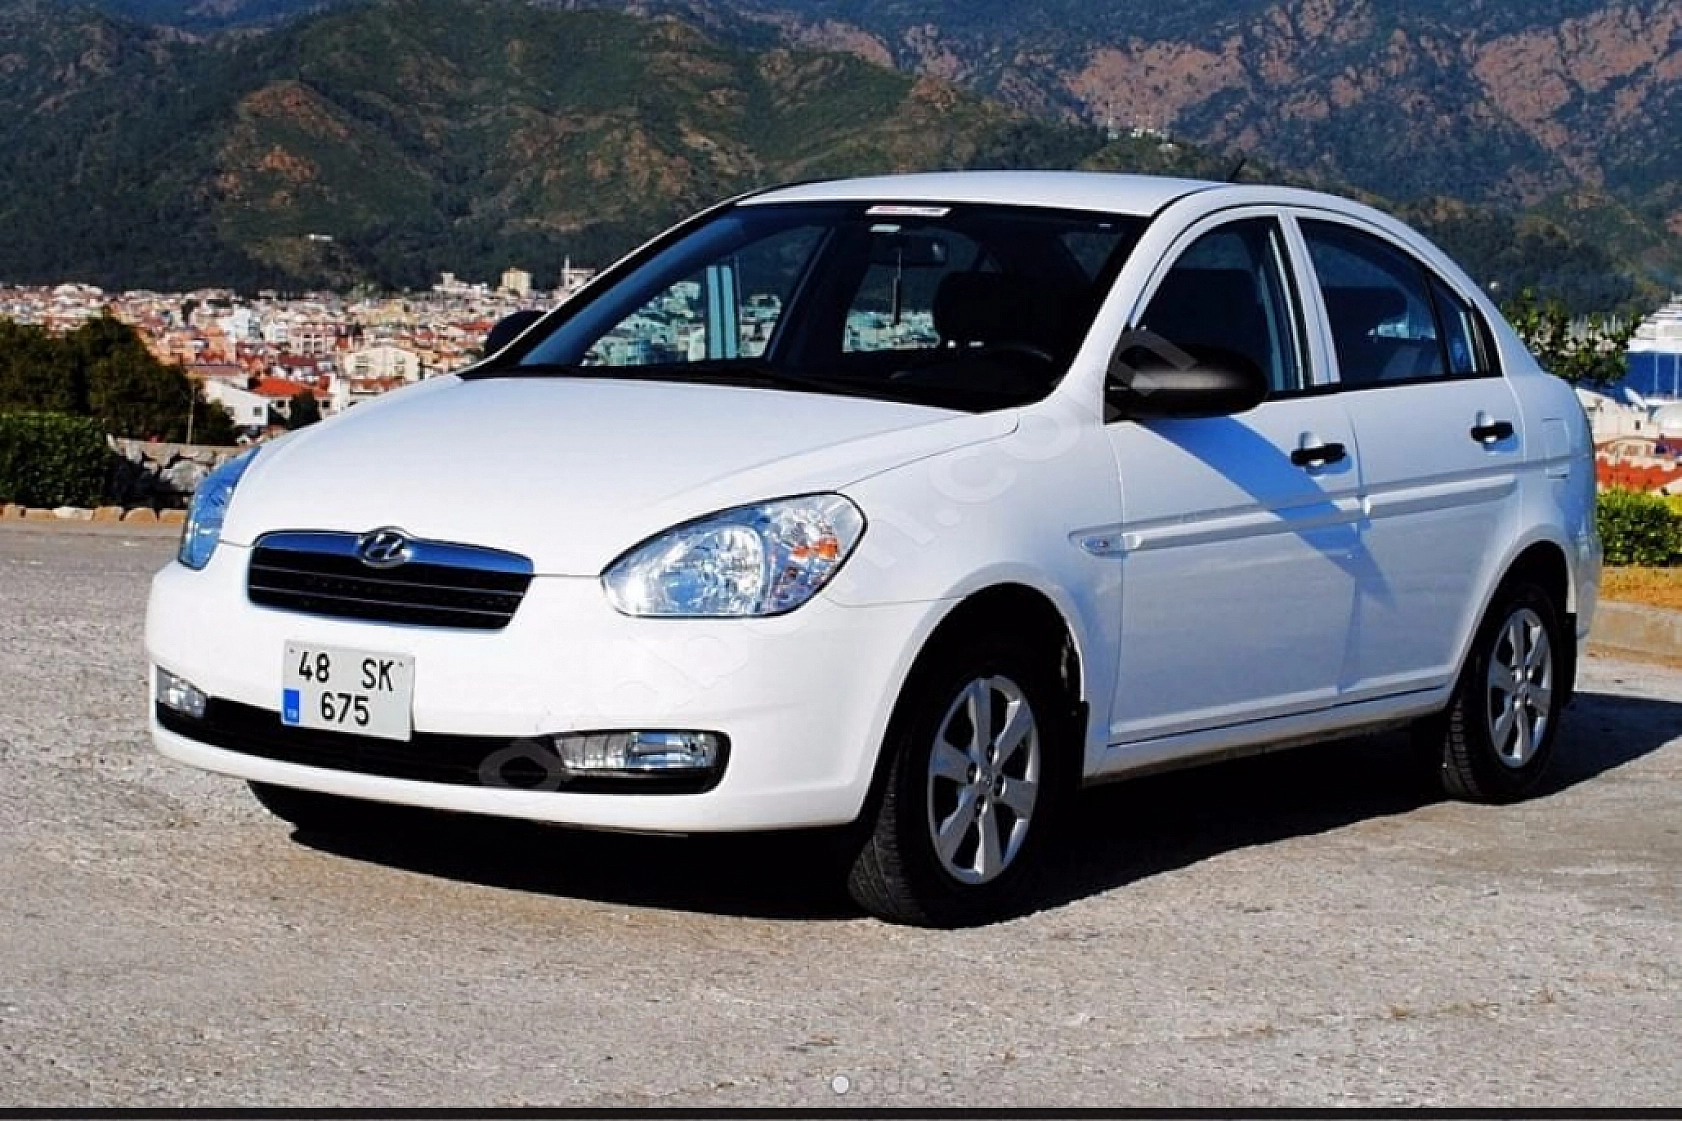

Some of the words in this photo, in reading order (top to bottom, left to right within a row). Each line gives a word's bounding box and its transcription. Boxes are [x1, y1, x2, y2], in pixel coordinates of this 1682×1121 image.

[298, 651, 330, 683] 48
[361, 657, 394, 691] SK
[321, 690, 369, 726] 675
